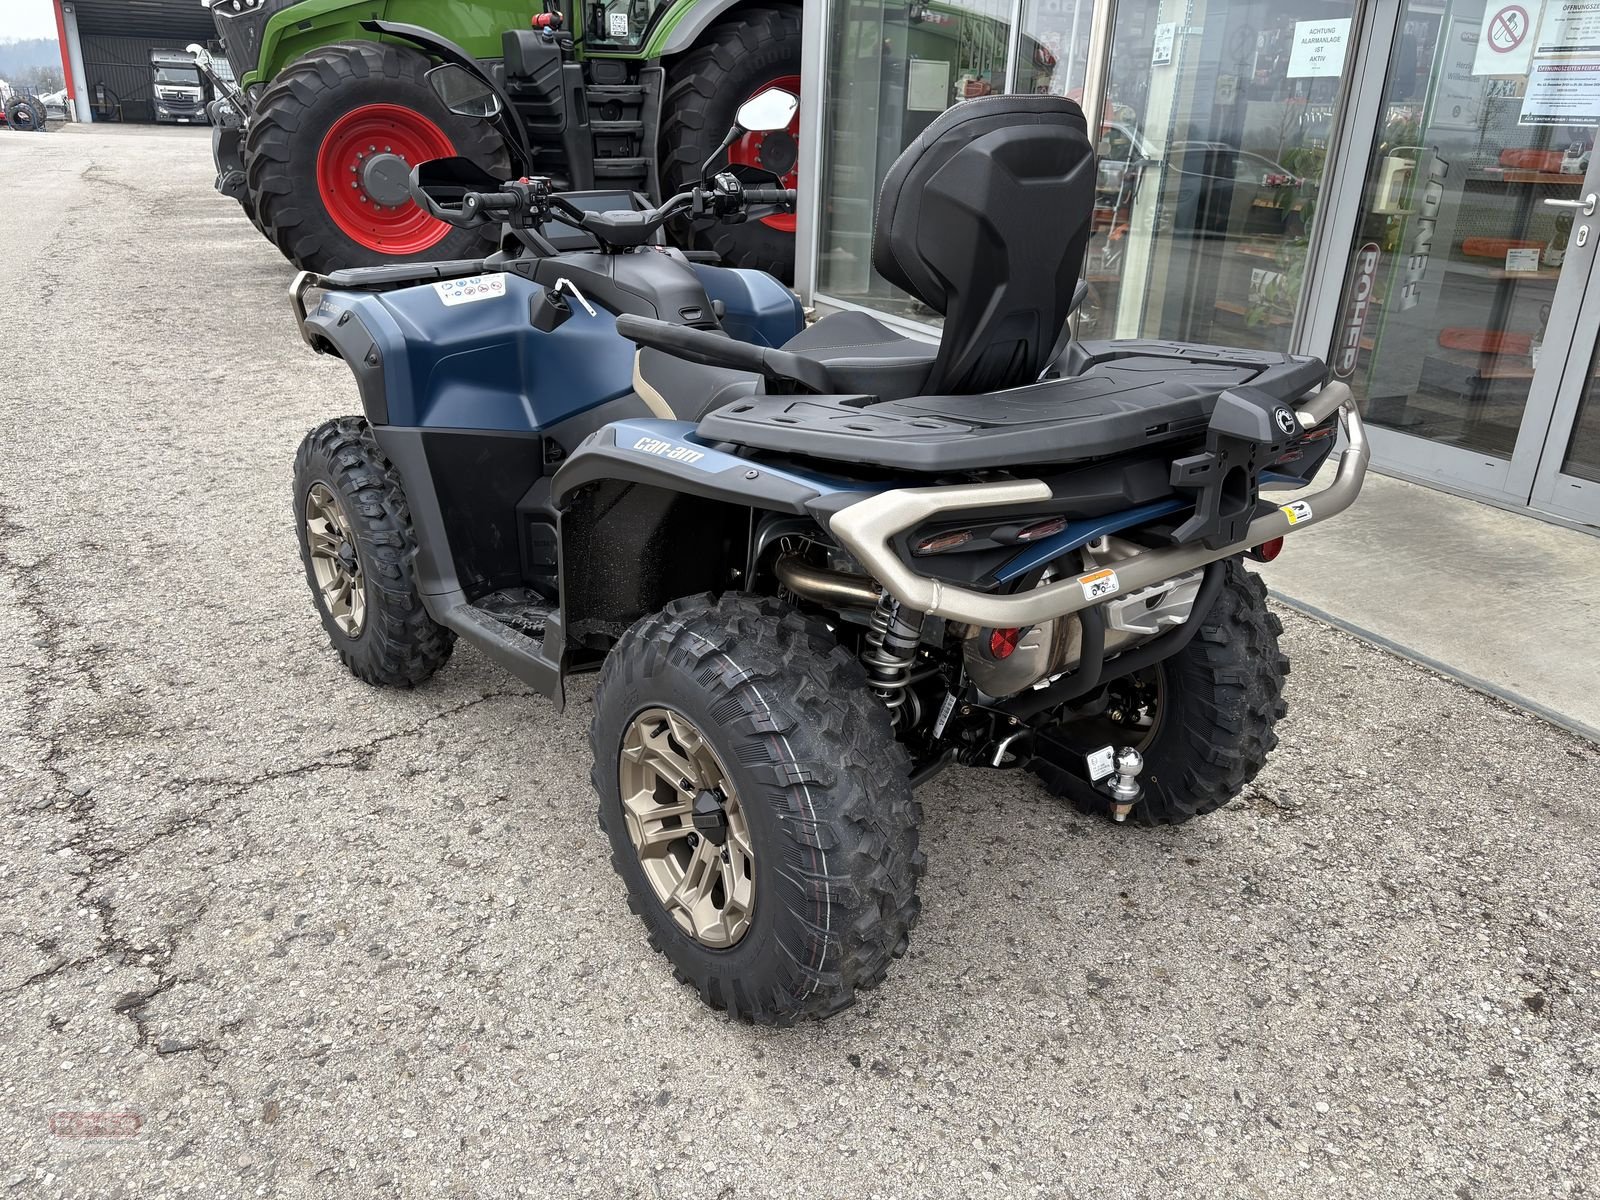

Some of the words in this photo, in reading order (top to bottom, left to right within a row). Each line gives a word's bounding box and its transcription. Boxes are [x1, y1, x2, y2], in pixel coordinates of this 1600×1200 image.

[1309, 27, 1336, 35] ACHTUNG
[1301, 36, 1341, 44] ALARMANLAGE
[1401, 145, 1450, 311] FENDT
[633, 436, 705, 463] can-am
